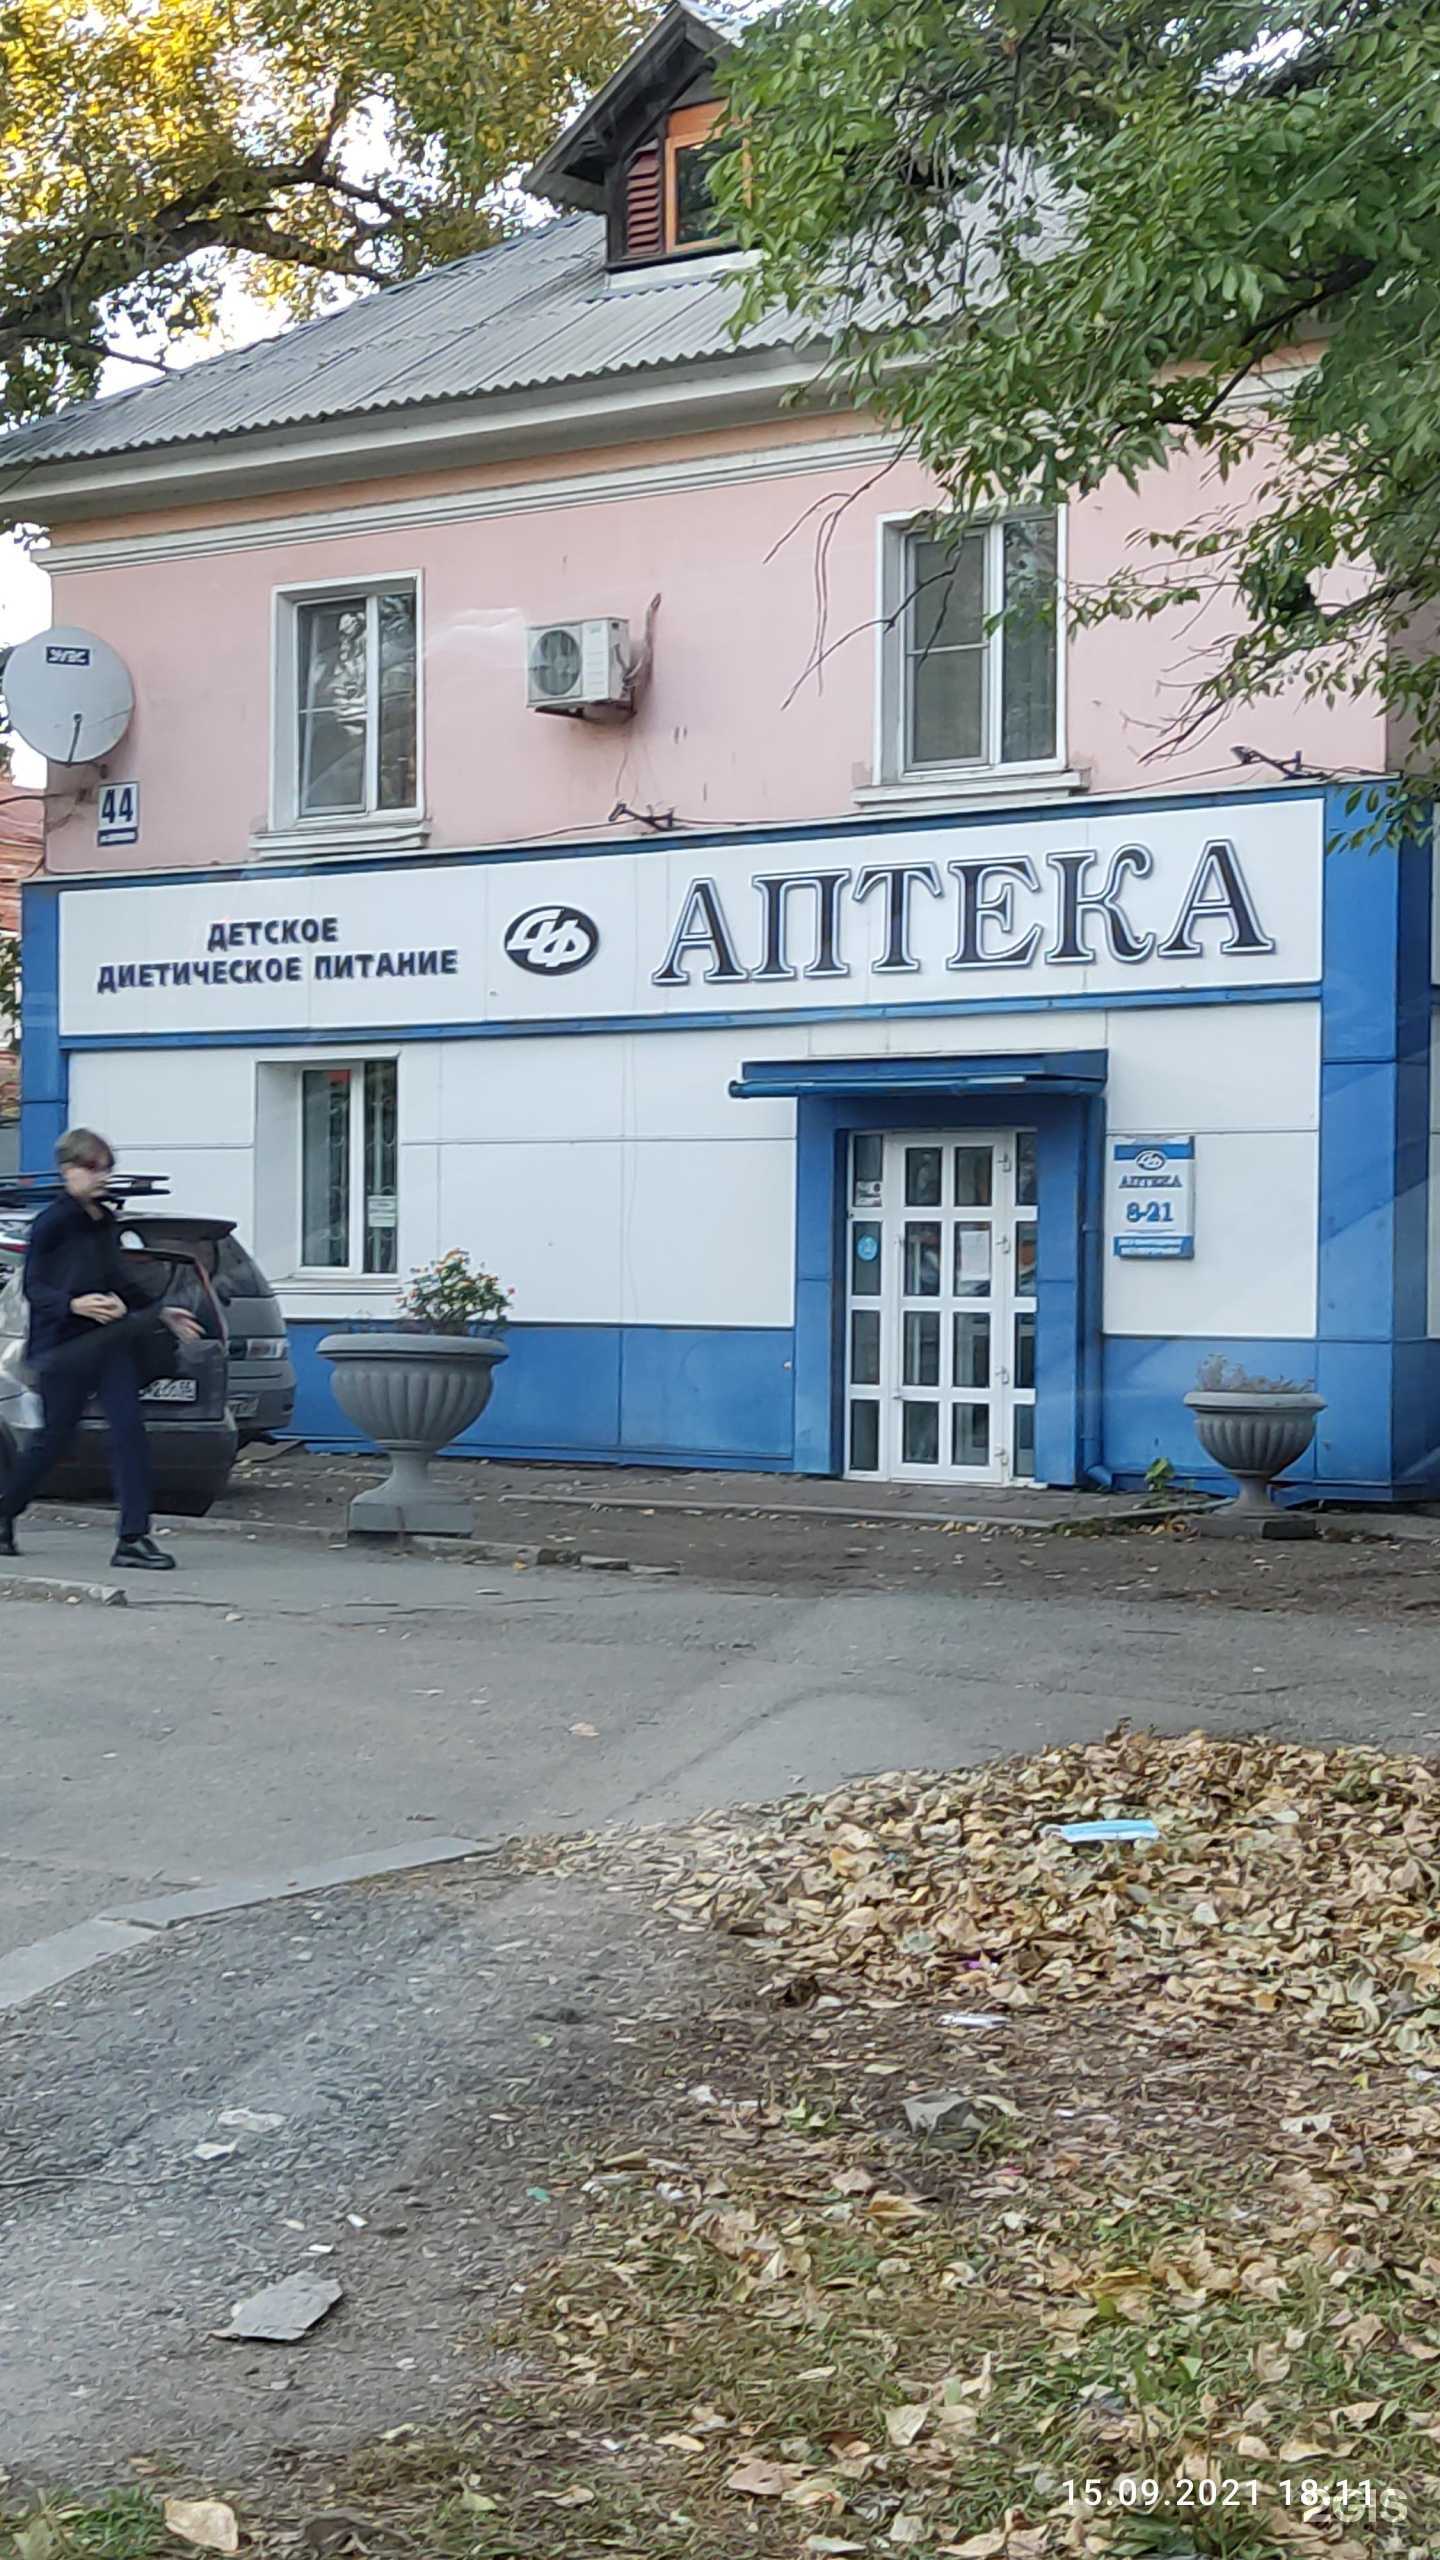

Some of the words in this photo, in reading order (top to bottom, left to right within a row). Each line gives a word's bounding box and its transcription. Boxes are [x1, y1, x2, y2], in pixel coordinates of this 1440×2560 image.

[101, 787, 134, 824] 44
[651, 838, 1277, 986] АПТЕКА
[207, 917, 338, 952] ДЕТСКОЕ
[97, 957, 301, 994] ДИЕТИЧЕСКОЕ
[314, 949, 458, 980] ПИТАНИЕ
[1118, 1175, 1183, 1189] АПТЕКА
